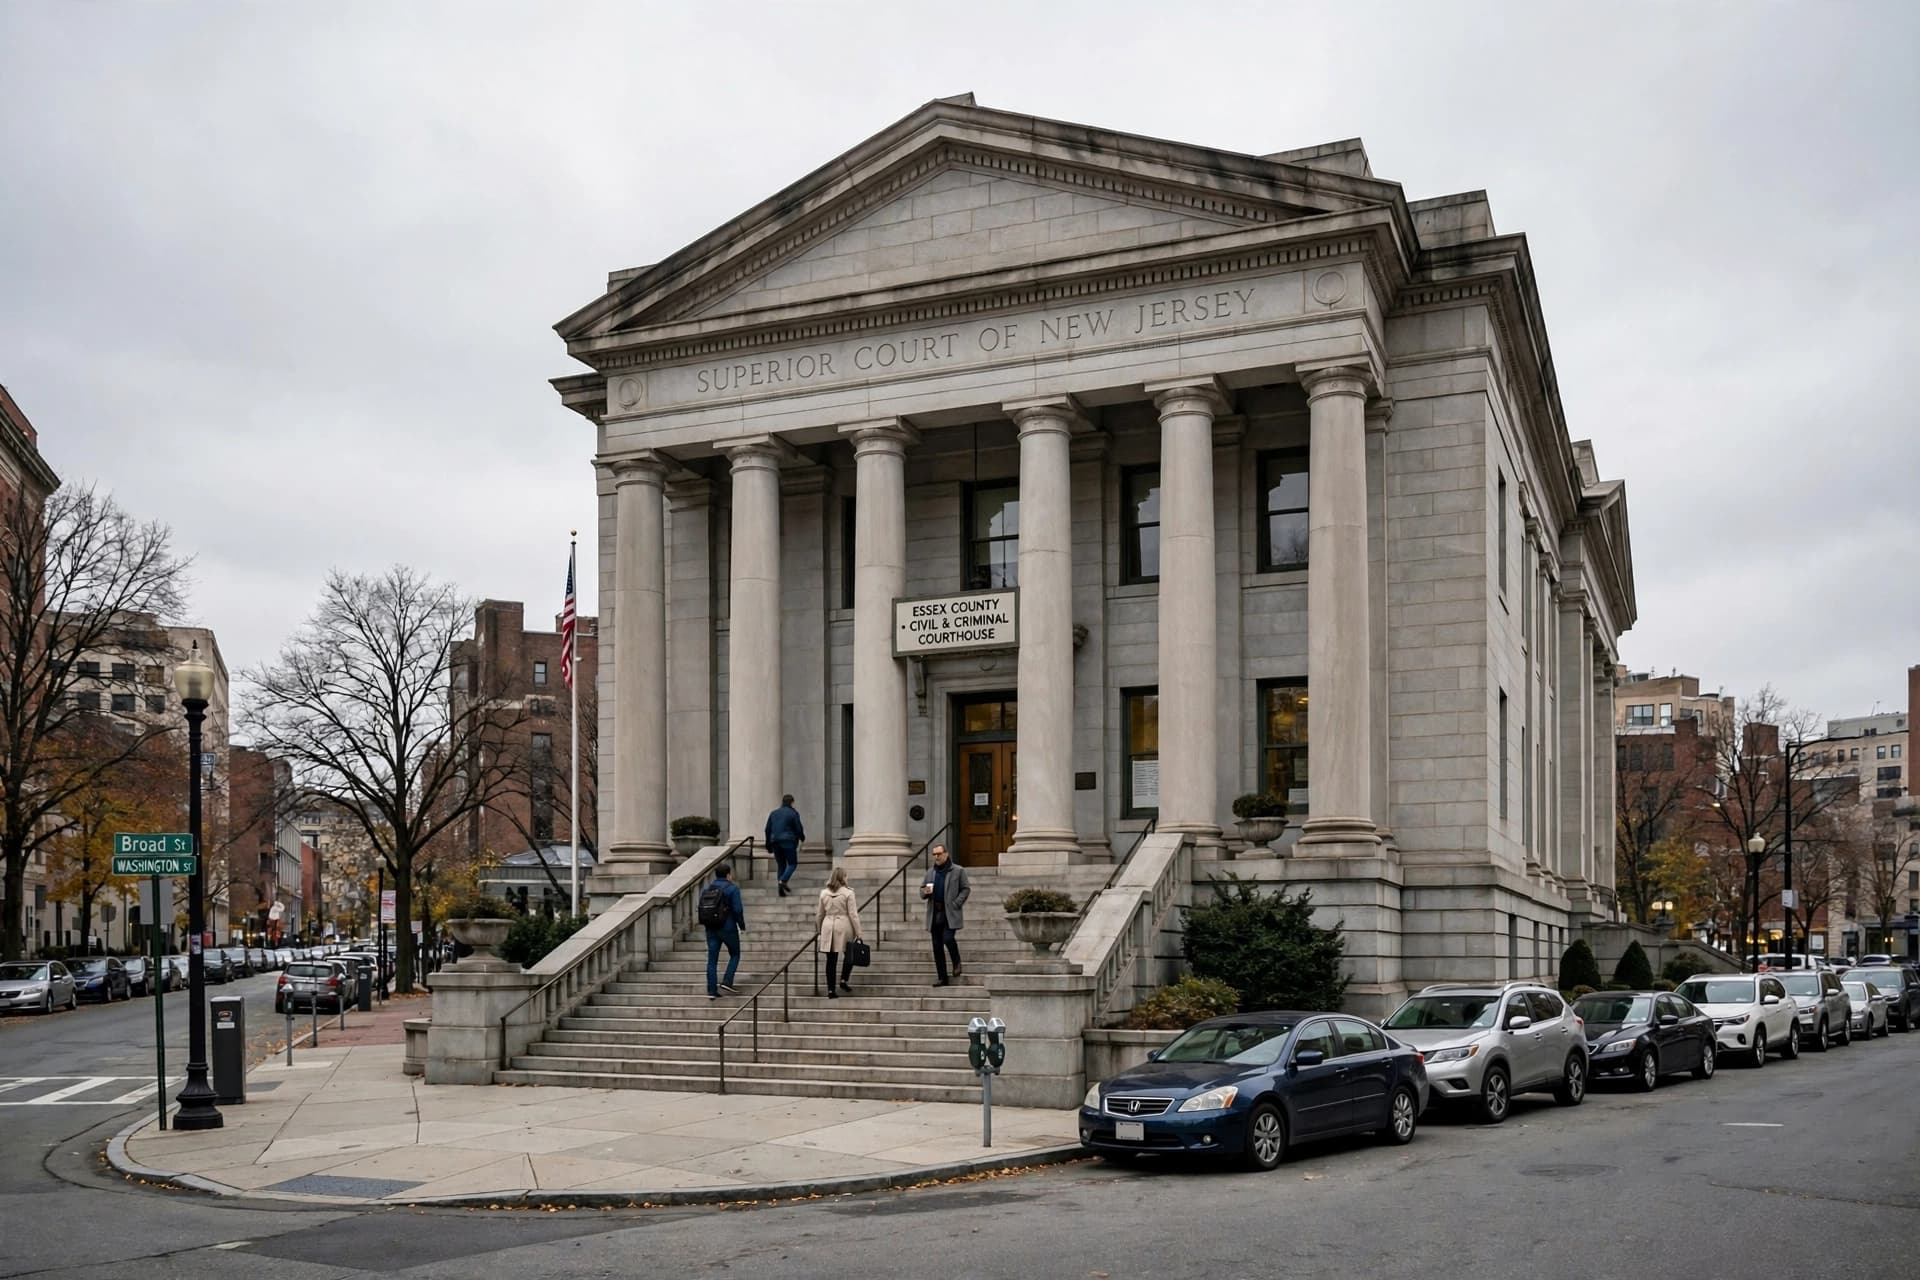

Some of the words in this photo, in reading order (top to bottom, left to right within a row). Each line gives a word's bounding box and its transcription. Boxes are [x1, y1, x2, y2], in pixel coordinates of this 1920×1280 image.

[697, 352, 836, 393] SUPERIOR
[853, 333, 959, 370] COURT
[979, 324, 1018, 351] OF
[1040, 309, 1114, 344] NEW
[1134, 288, 1255, 334] JERSEY
[912, 603, 947, 617] ESSEX
[951, 598, 1000, 614] COUNTY
[909, 619, 938, 632] CIVIL
[942, 617, 950, 629] &
[954, 613, 1009, 628] CRIMINAL
[918, 628, 995, 645] COURTHOUSE
[121, 835, 166, 852] Broad
[174, 838, 186, 851] St
